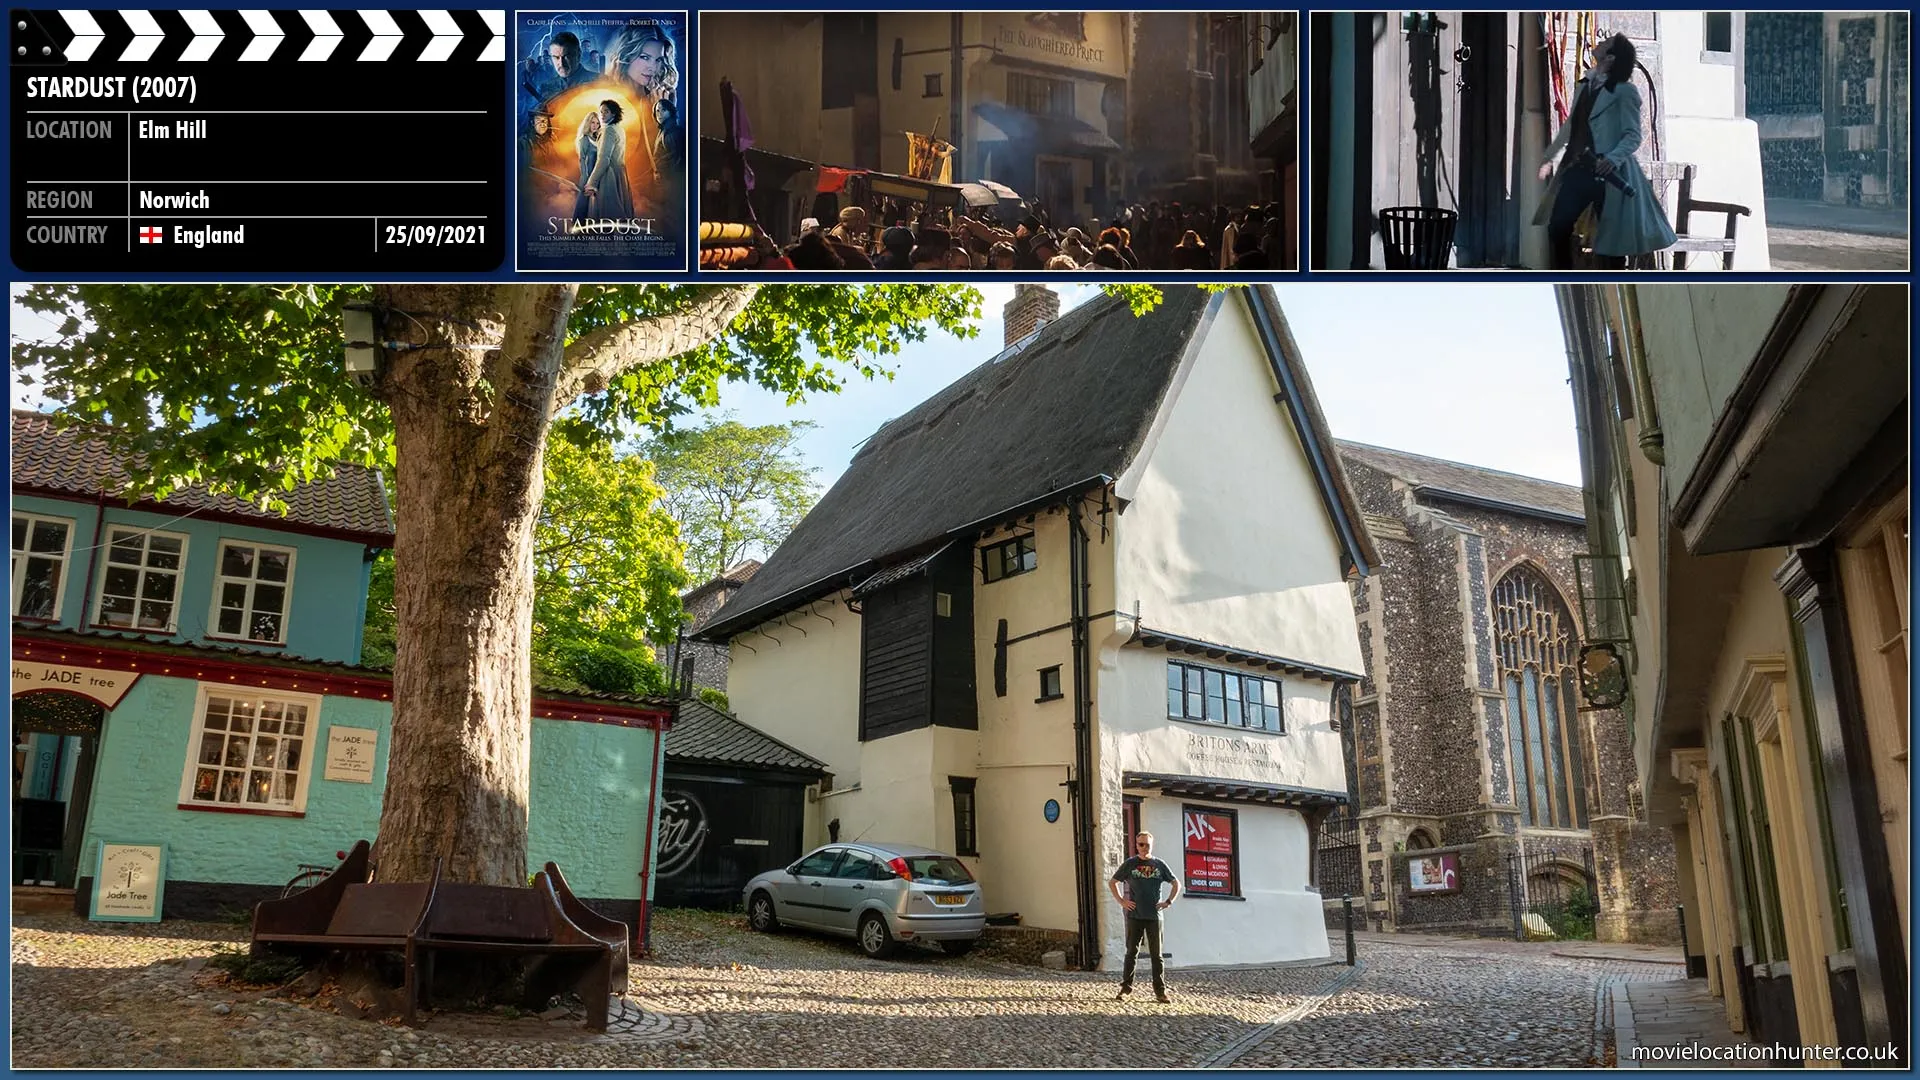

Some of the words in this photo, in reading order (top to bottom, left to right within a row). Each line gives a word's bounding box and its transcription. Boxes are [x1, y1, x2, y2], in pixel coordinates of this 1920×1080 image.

[547, 216, 656, 235] STARDUST
[12, 667, 32, 680] the
[40, 669, 82, 684] JADE
[89, 677, 115, 688] tree
[342, 735, 362, 744] JADE
[1188, 733, 1241, 752] BRITONS
[1243, 741, 1273, 756] ARMS
[1184, 812, 1216, 848] AK
[1191, 879, 1208, 887] UNDER
[106, 890, 127, 900] Jade
[128, 891, 148, 900] Tree
